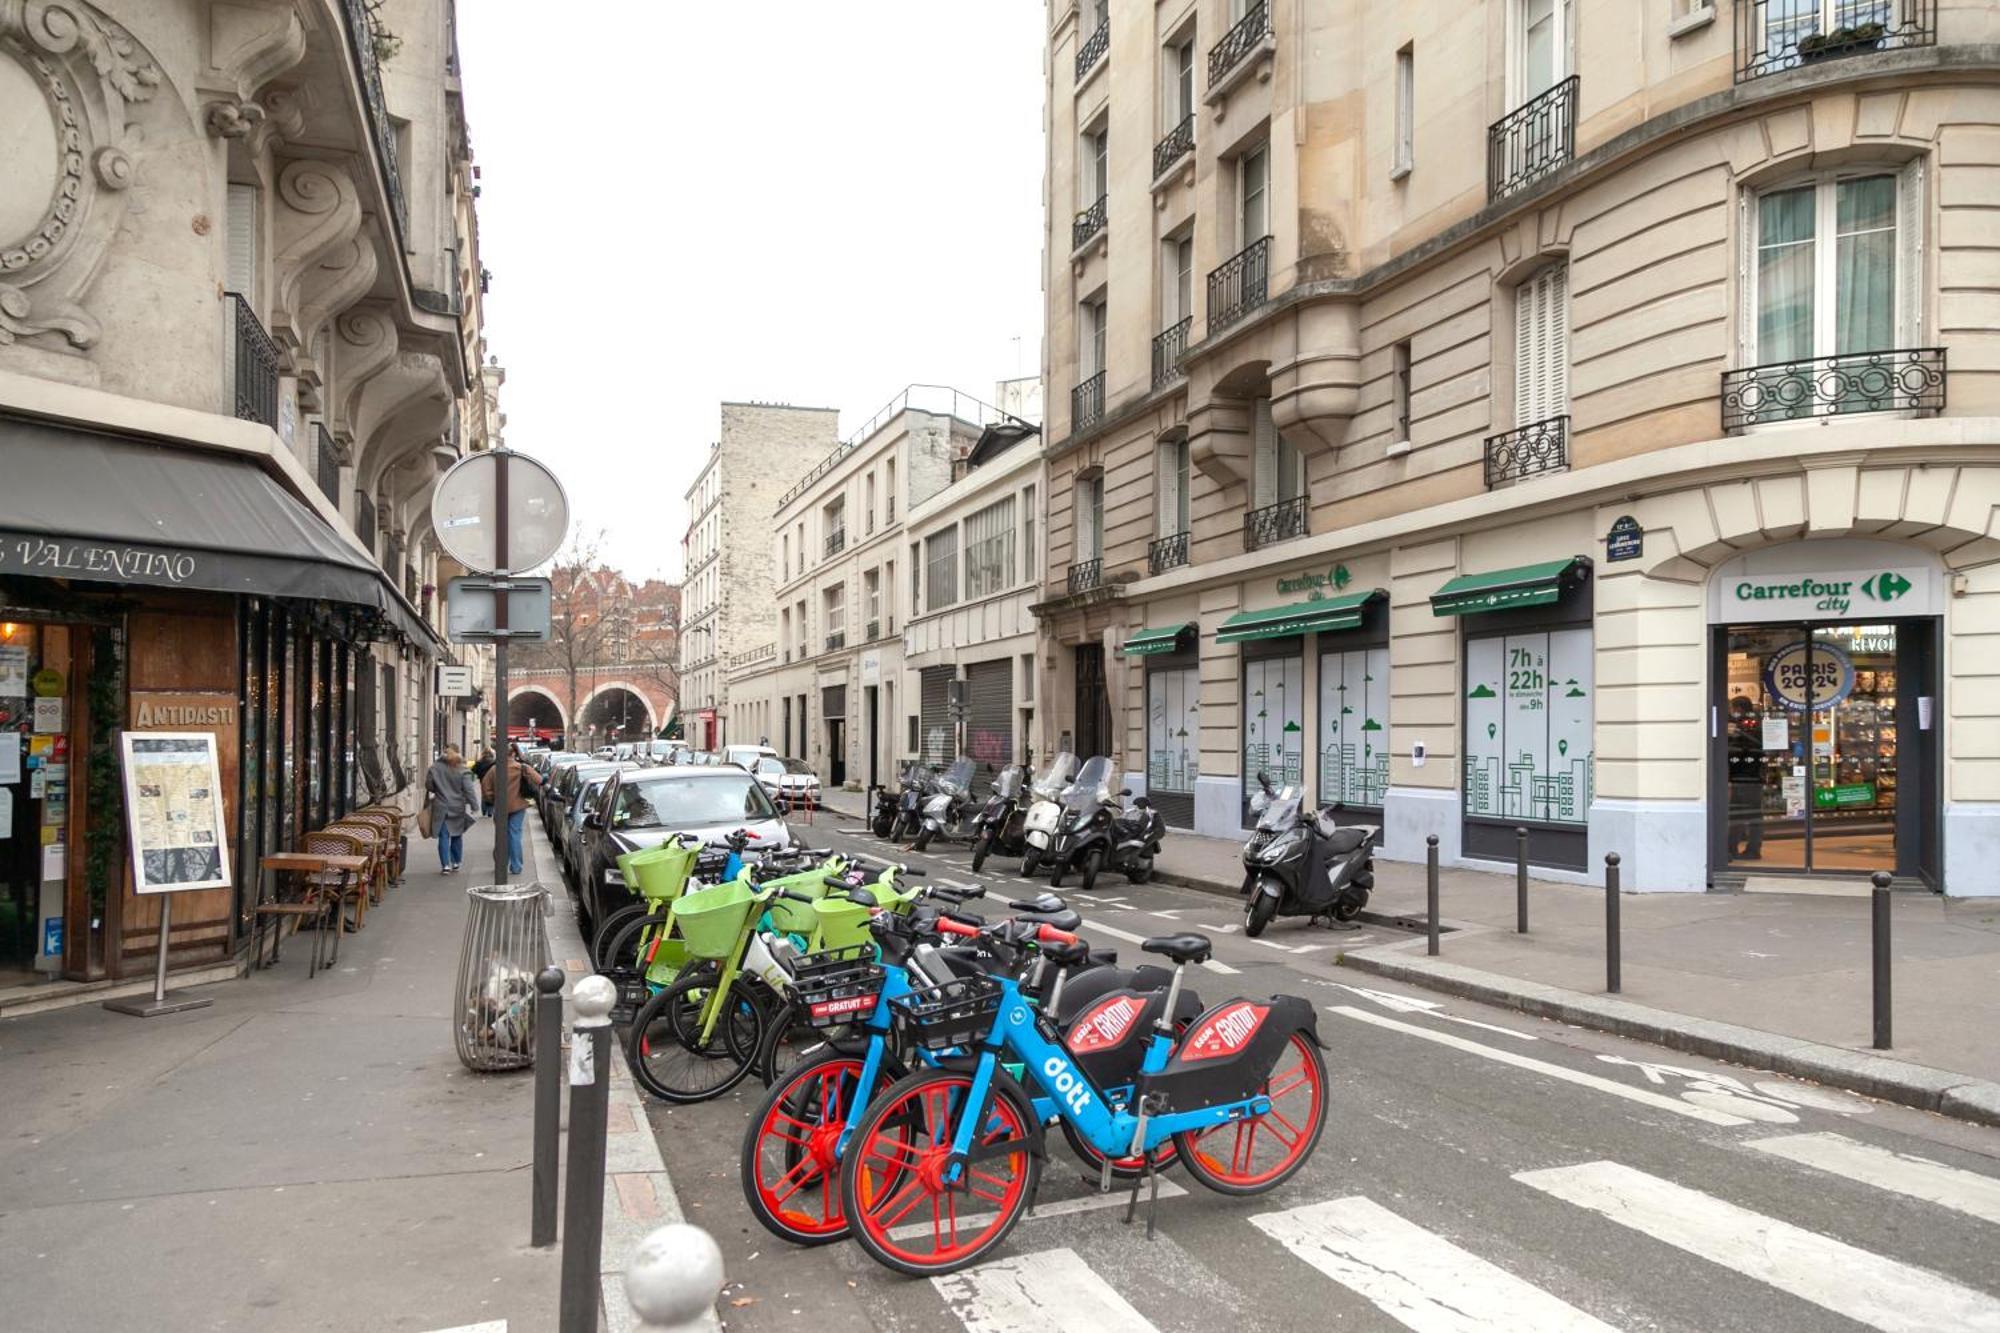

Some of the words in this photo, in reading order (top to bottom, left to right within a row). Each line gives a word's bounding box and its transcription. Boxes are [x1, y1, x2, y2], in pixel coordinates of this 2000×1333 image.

[17, 539, 196, 582] VALENTINO
[1736, 578, 1853, 600] Carrefour
[1816, 597, 1851, 615] city
[1510, 647, 1531, 668] 7h
[1537, 654, 1543, 667] à
[1510, 669, 1543, 690] 22h
[1781, 662, 1837, 677] PARIS
[1781, 674, 1838, 690] 2024
[1530, 698, 1543, 710] 9h
[828, 998, 862, 1013] GRATUIT
[1093, 999, 1135, 1041] GRATUIT
[1216, 1006, 1258, 1049] GRATUIT
[1044, 1057, 1091, 1116] dott
